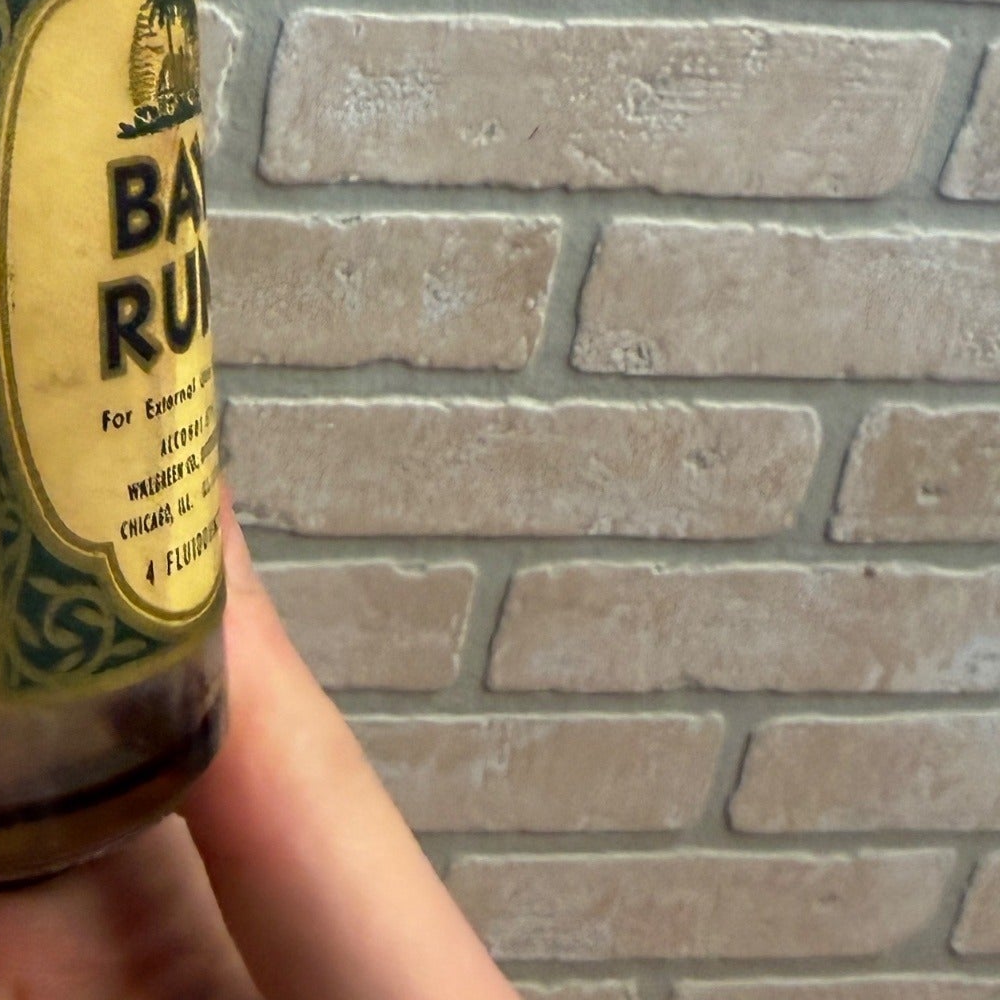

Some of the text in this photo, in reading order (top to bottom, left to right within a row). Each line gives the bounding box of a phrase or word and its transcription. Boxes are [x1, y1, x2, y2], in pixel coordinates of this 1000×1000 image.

[102, 410, 133, 432] For
[146, 377, 196, 420] External
[127, 461, 184, 501] WALGREEN
[146, 559, 155, 586] 4
